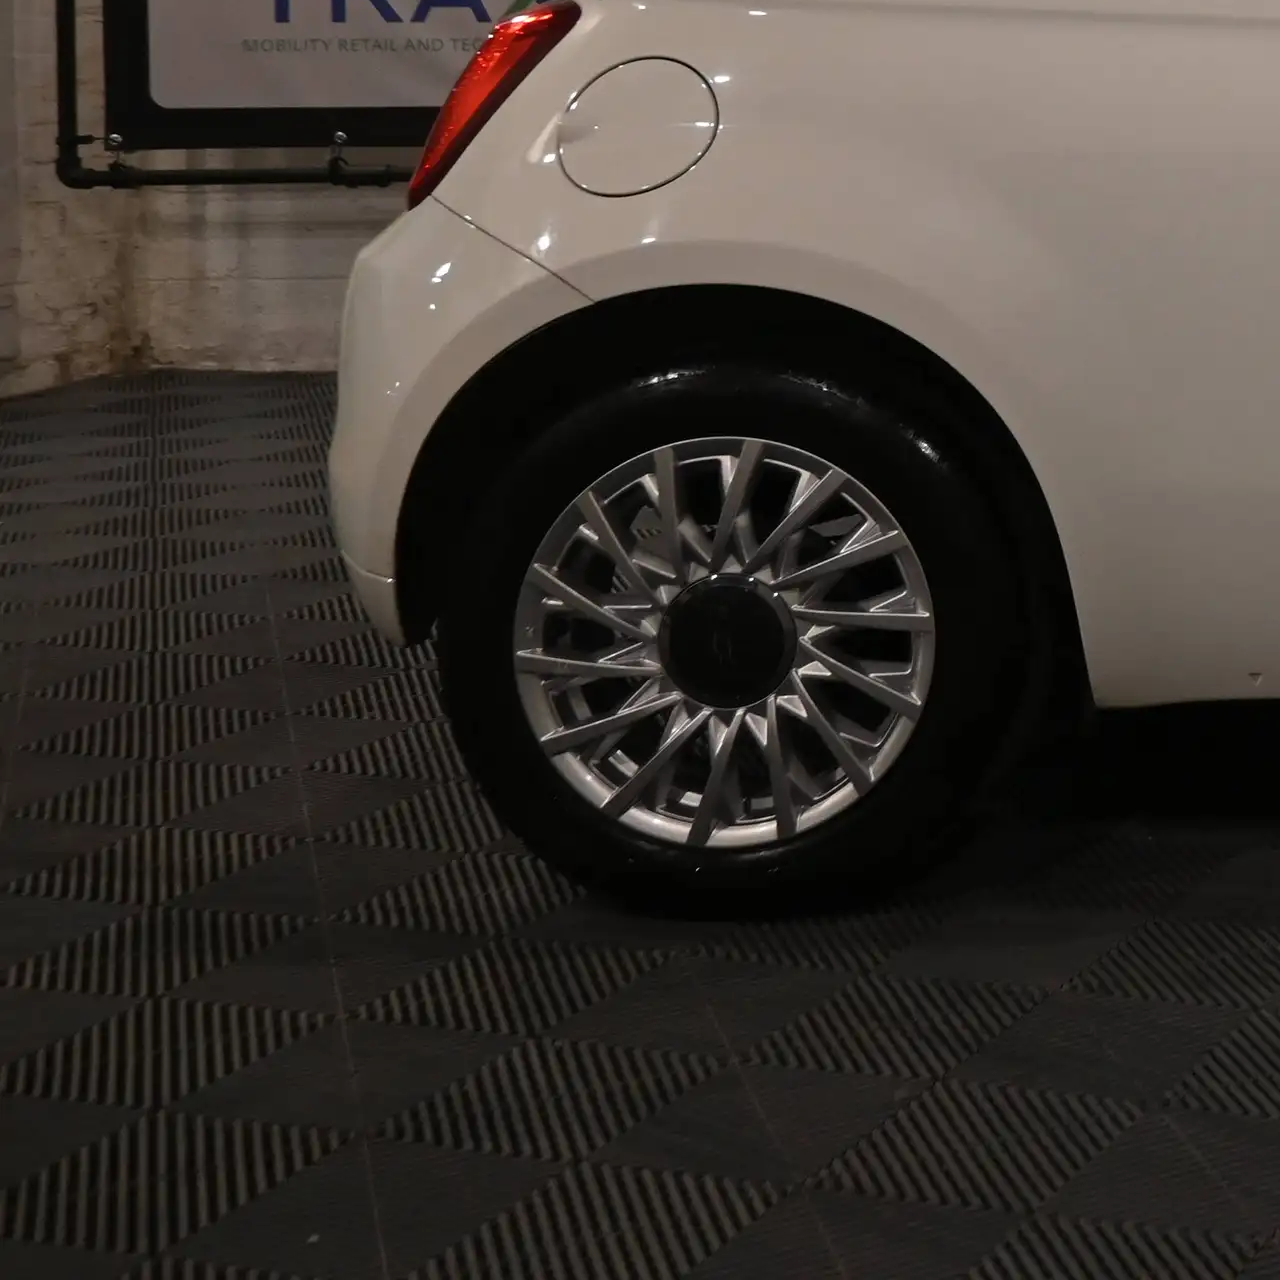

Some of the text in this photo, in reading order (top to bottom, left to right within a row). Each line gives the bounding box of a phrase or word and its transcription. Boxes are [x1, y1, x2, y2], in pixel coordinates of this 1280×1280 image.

[241, 37, 334, 53] MOBILITY
[337, 37, 398, 53] RETAIL
[404, 37, 445, 53] AND
